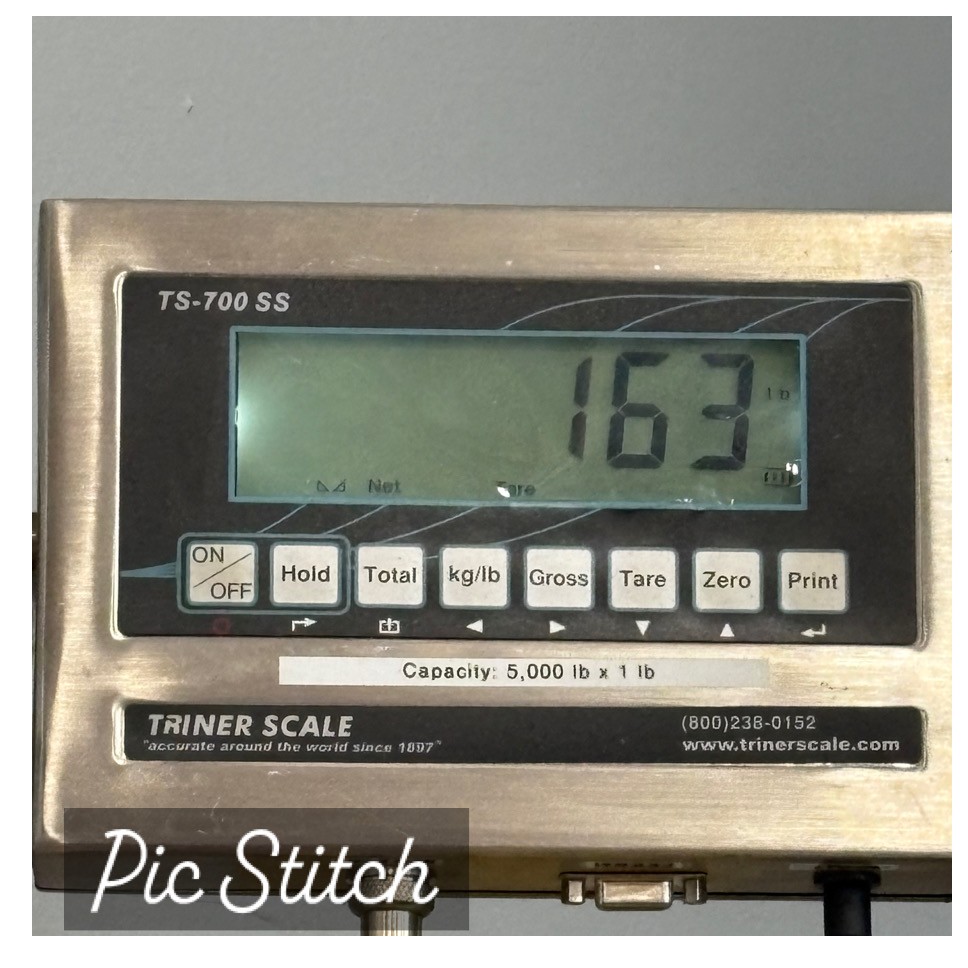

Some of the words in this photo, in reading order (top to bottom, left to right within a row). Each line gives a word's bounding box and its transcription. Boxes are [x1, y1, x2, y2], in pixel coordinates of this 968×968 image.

[158, 291, 249, 312] TS-700
[255, 292, 290, 313] SS
[568, 351, 754, 470] 163
[192, 546, 225, 564] ON
[281, 566, 331, 583] Hold
[364, 566, 417, 583] Total
[448, 566, 500, 586] kg/lb
[529, 569, 589, 587] Gross
[619, 570, 667, 588] Tare
[703, 571, 751, 588] Zero
[788, 572, 839, 590] Print
[210, 583, 253, 599] OFF
[402, 662, 497, 681] Capacity:
[506, 663, 564, 682] 5,000
[572, 664, 590, 680] lb
[599, 667, 609, 680] x
[619, 665, 627, 680] 1
[638, 665, 655, 680] lb
[148, 714, 253, 737] TRINER
[261, 714, 354, 737] SCALE
[278, 741, 301, 752] the
[682, 736, 900, 752] www.trinerscale.com
